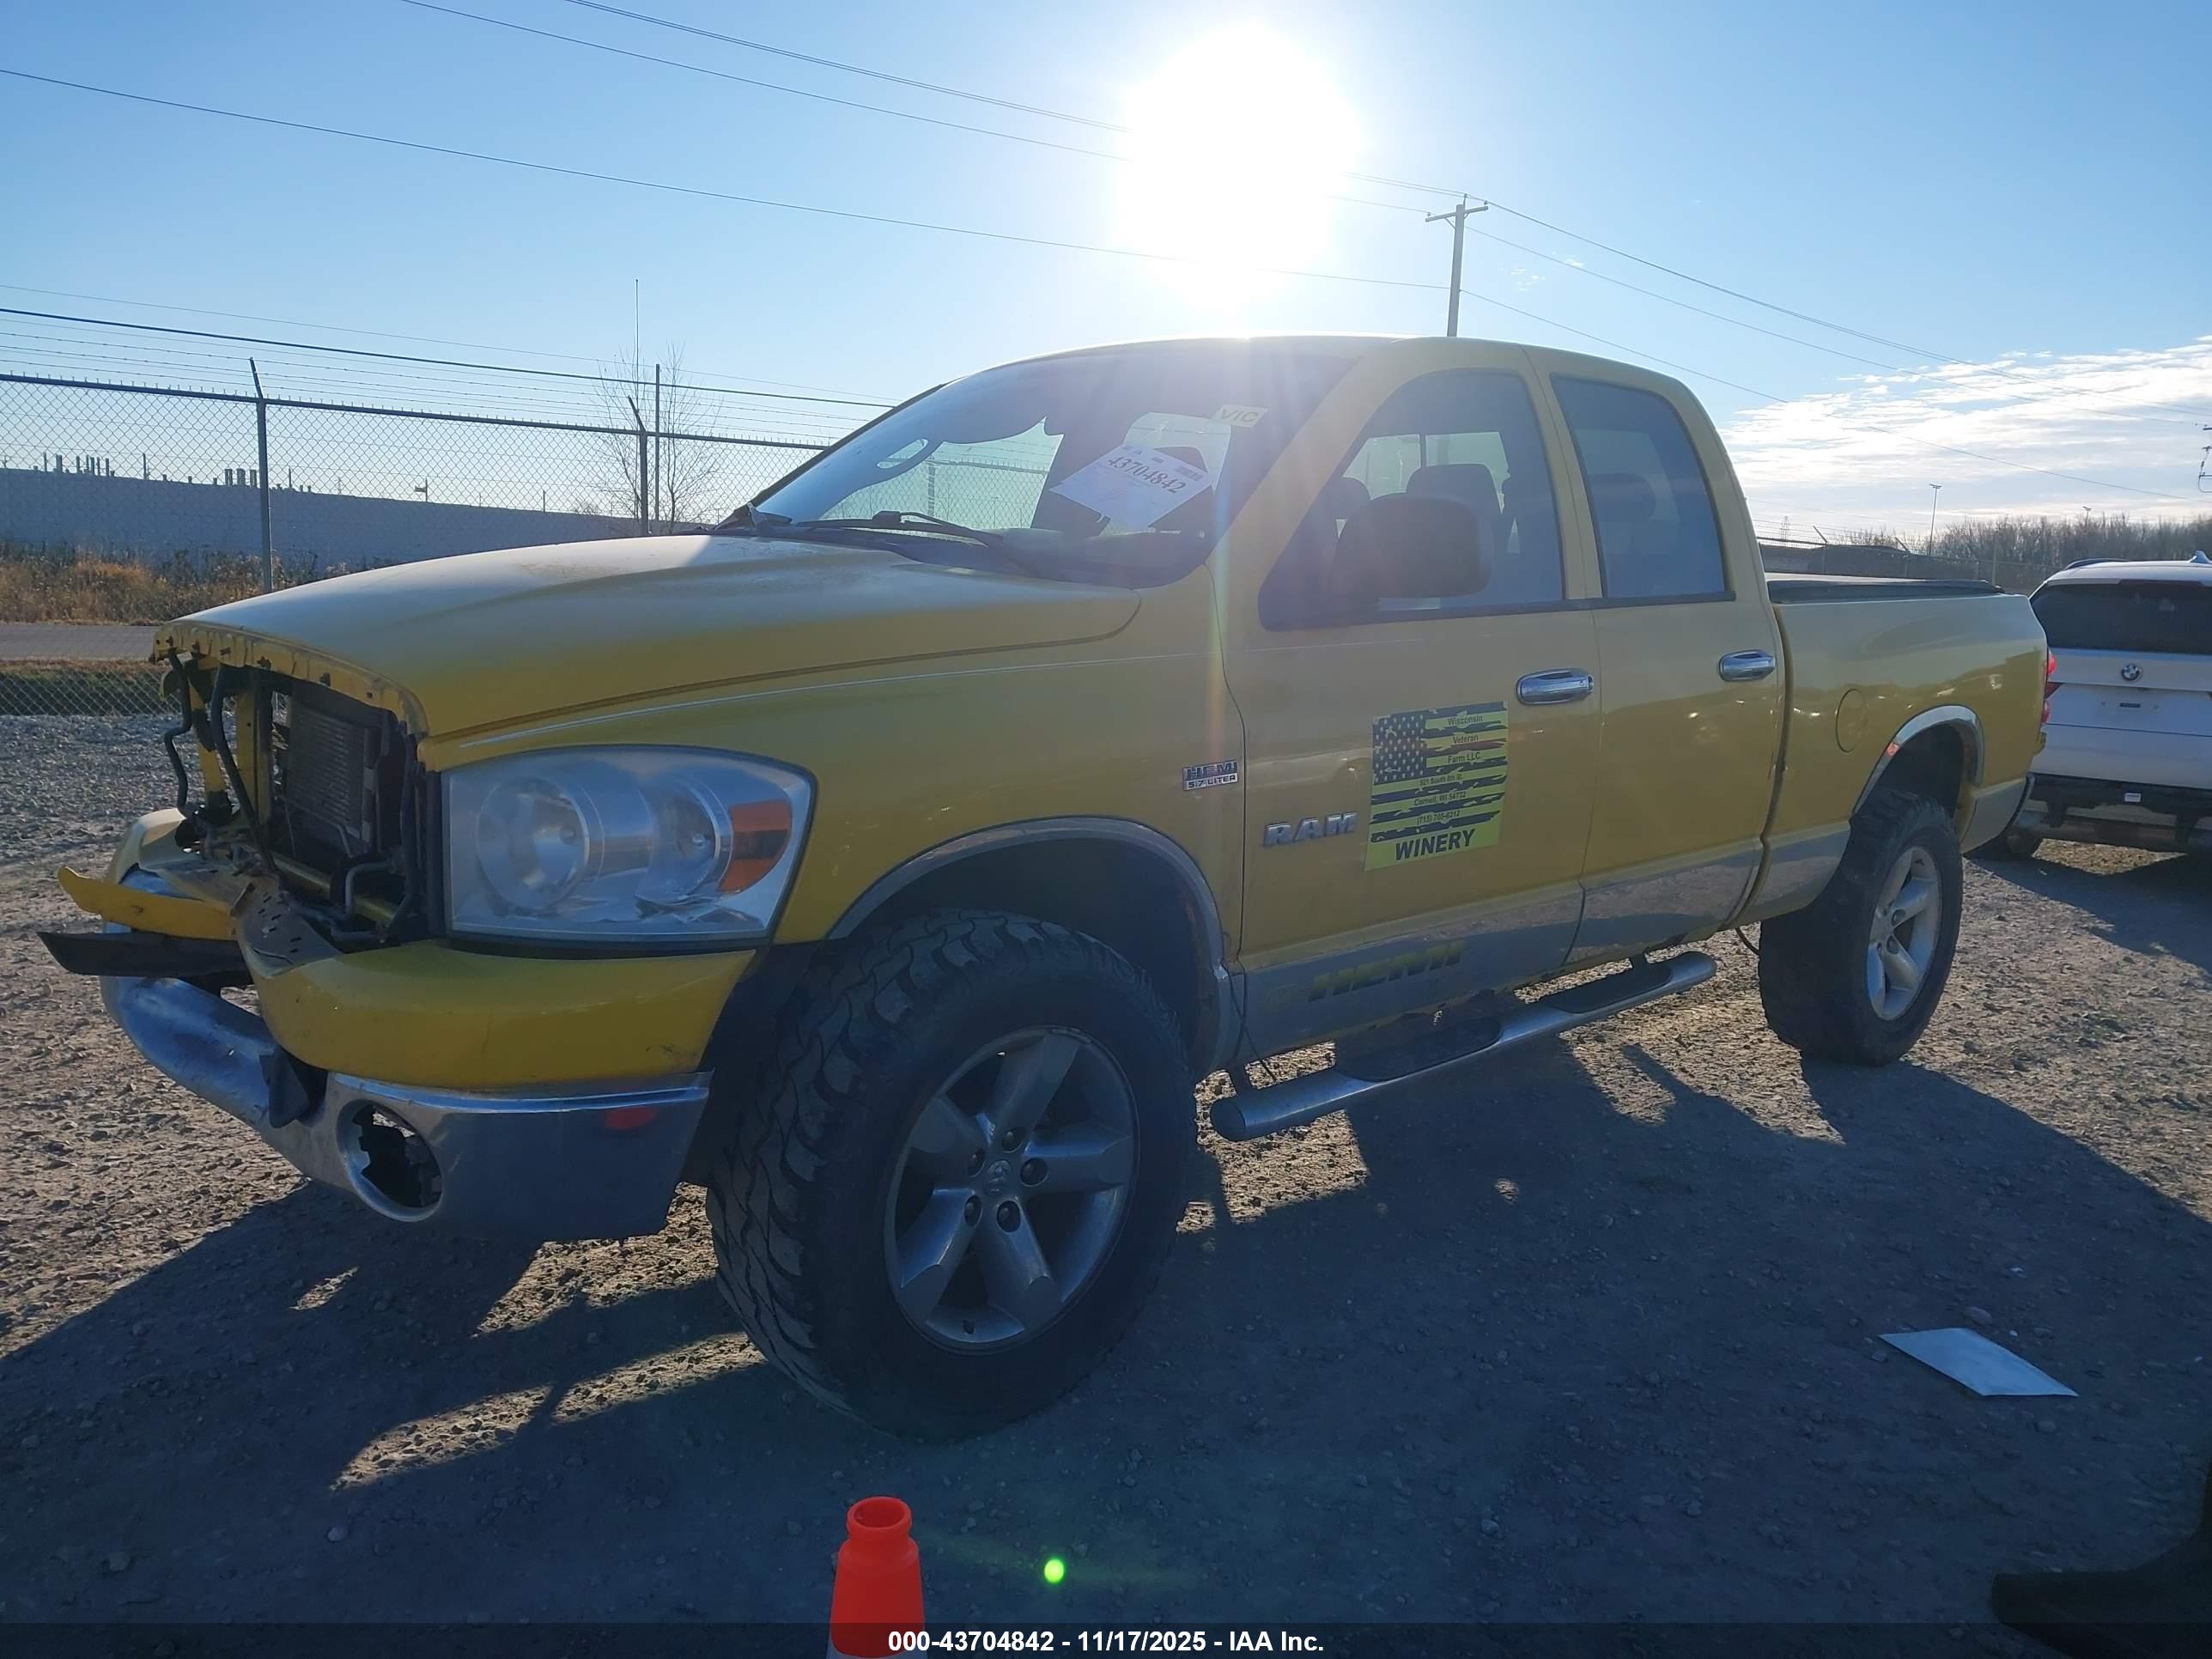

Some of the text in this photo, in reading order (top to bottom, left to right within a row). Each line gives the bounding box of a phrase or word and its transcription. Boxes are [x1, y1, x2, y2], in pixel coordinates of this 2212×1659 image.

[1220, 407, 1260, 423] VIC
[1108, 456, 1188, 494] 43704842
[1448, 714, 1483, 726] Wisconsin
[1452, 734, 1479, 744] Veteran
[1448, 750, 1481, 764] Farm LLC
[1187, 761, 1238, 781] HEMI
[1207, 774, 1237, 785] LITER
[1263, 811, 1358, 847] RAM
[1395, 828, 1476, 860] WINERY
